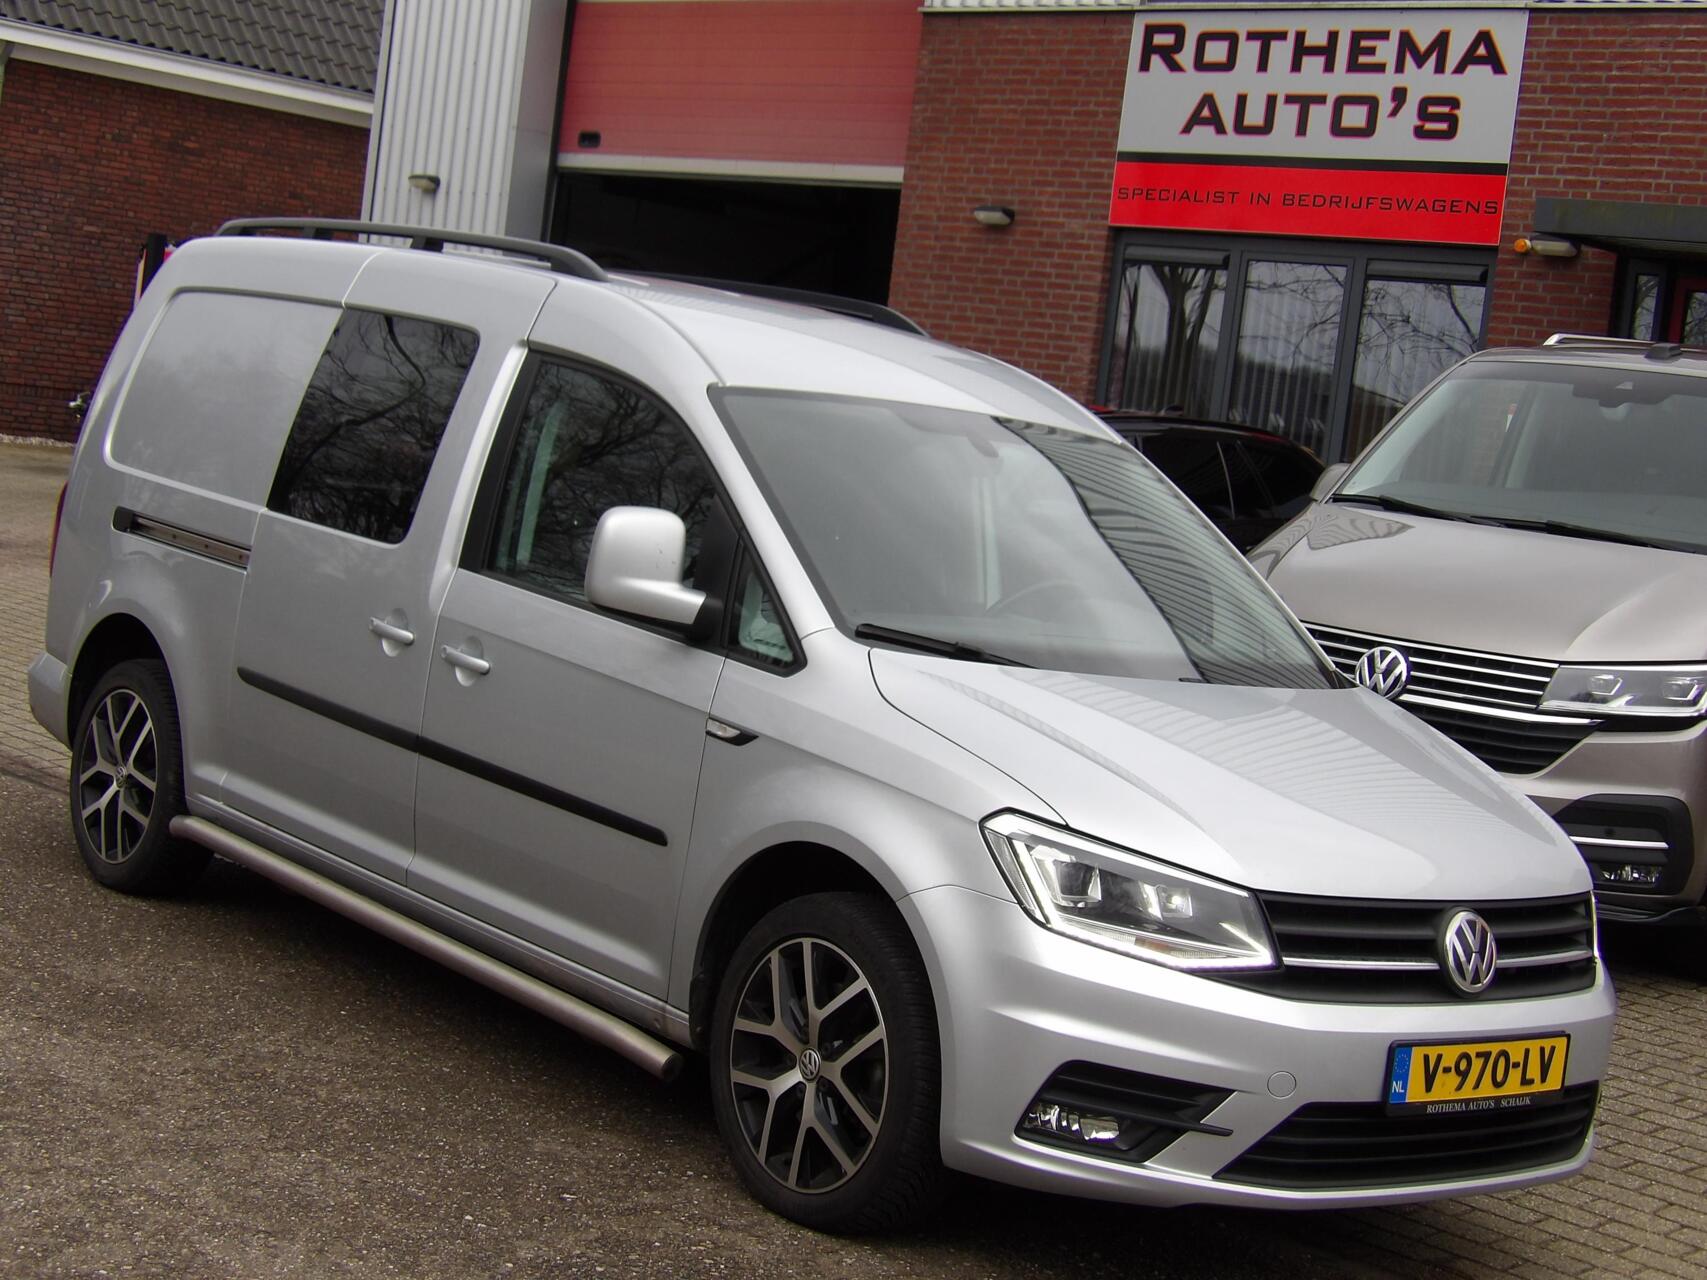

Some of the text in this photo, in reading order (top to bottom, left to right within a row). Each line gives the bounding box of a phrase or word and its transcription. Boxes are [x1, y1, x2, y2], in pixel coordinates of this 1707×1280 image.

[1138, 23, 1508, 75] ROTHEMA
[1180, 86, 1462, 141] AUTO'S
[1117, 187, 1499, 216] SPECIALIST IN BEDRIJFSWAGENS
[1446, 911, 1496, 993] VW
[1391, 1081, 1405, 1094] NL
[1423, 1045, 1556, 1094] V-970-LV
[1426, 1103, 1466, 1114] ROTHEMA
[1467, 1100, 1495, 1112] AUTO'S
